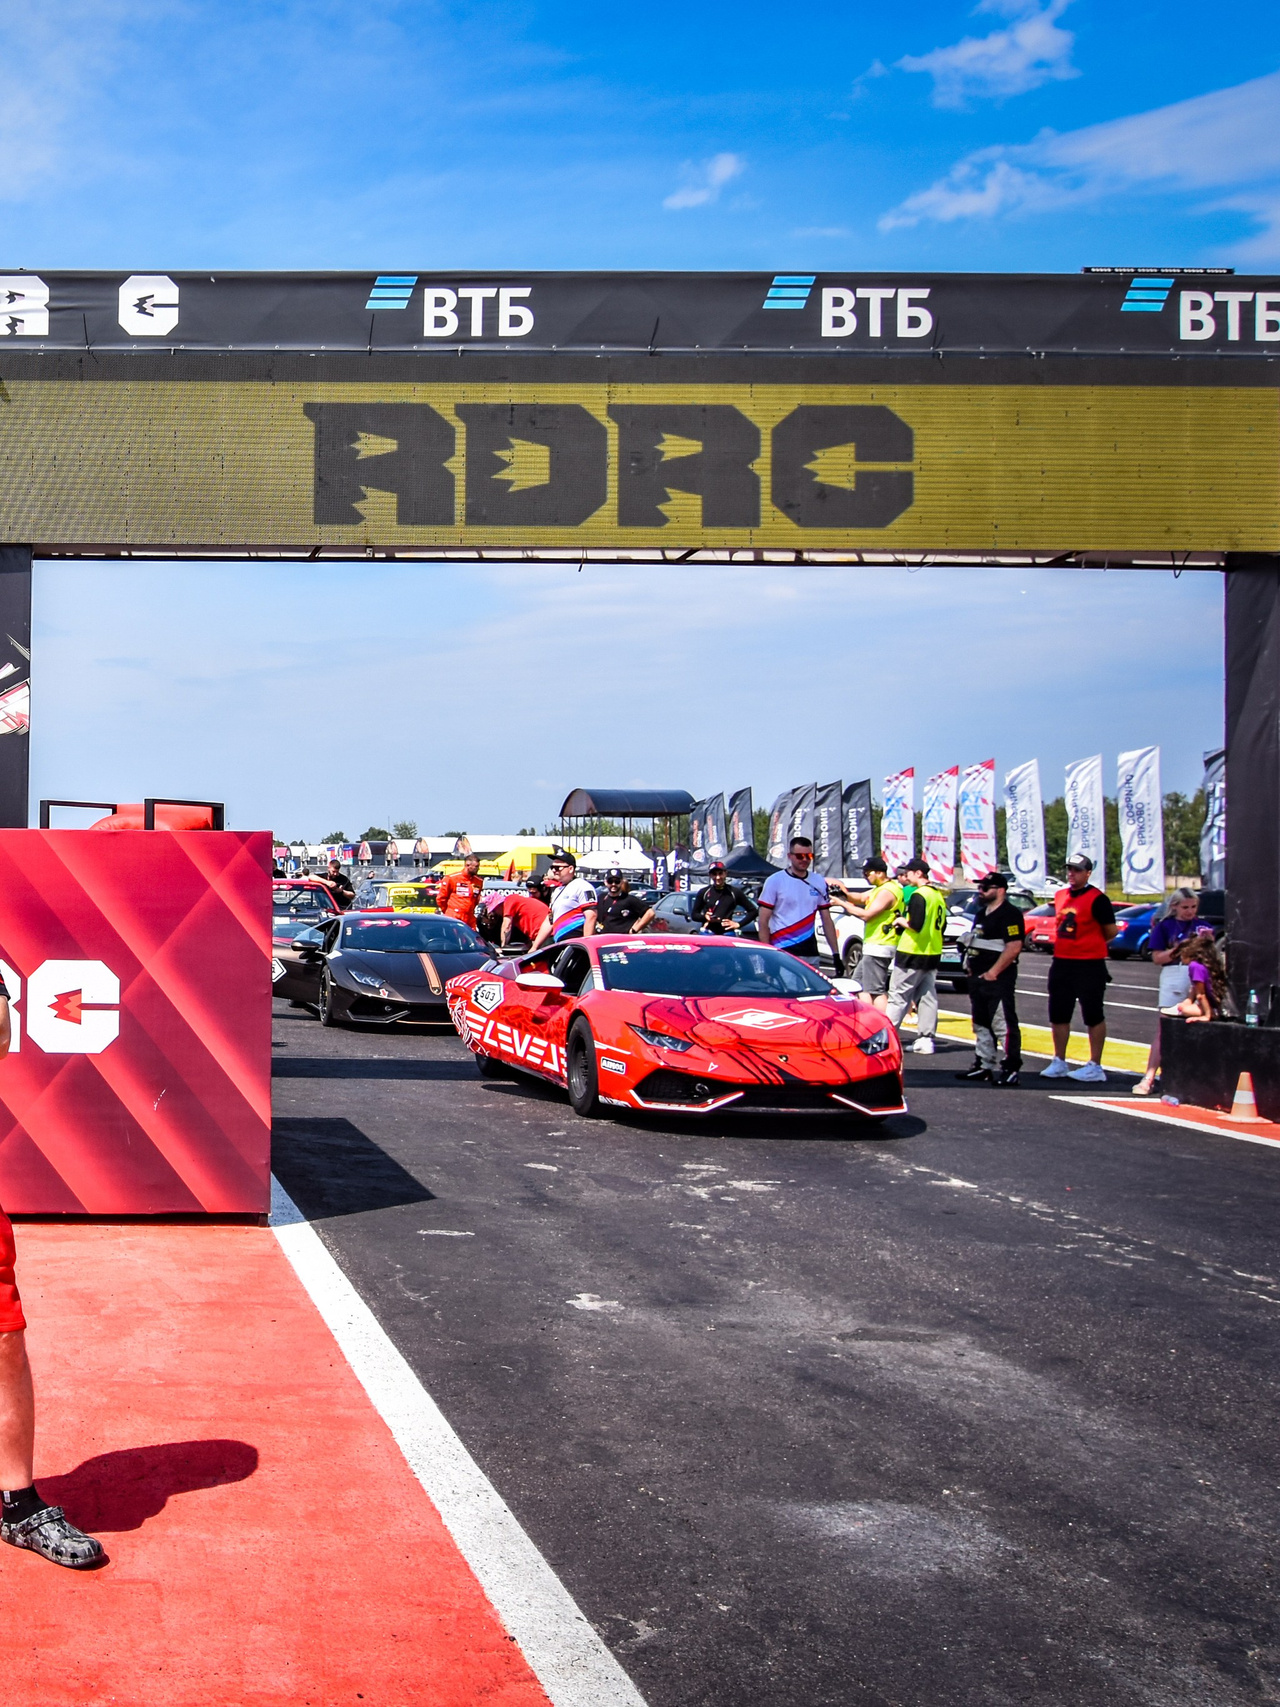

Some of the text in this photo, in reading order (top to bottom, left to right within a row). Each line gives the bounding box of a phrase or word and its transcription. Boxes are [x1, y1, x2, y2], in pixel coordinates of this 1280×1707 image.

[423, 287, 535, 337] ВТБ
[821, 287, 934, 338] ВТБ
[303, 402, 915, 528] RDRC
